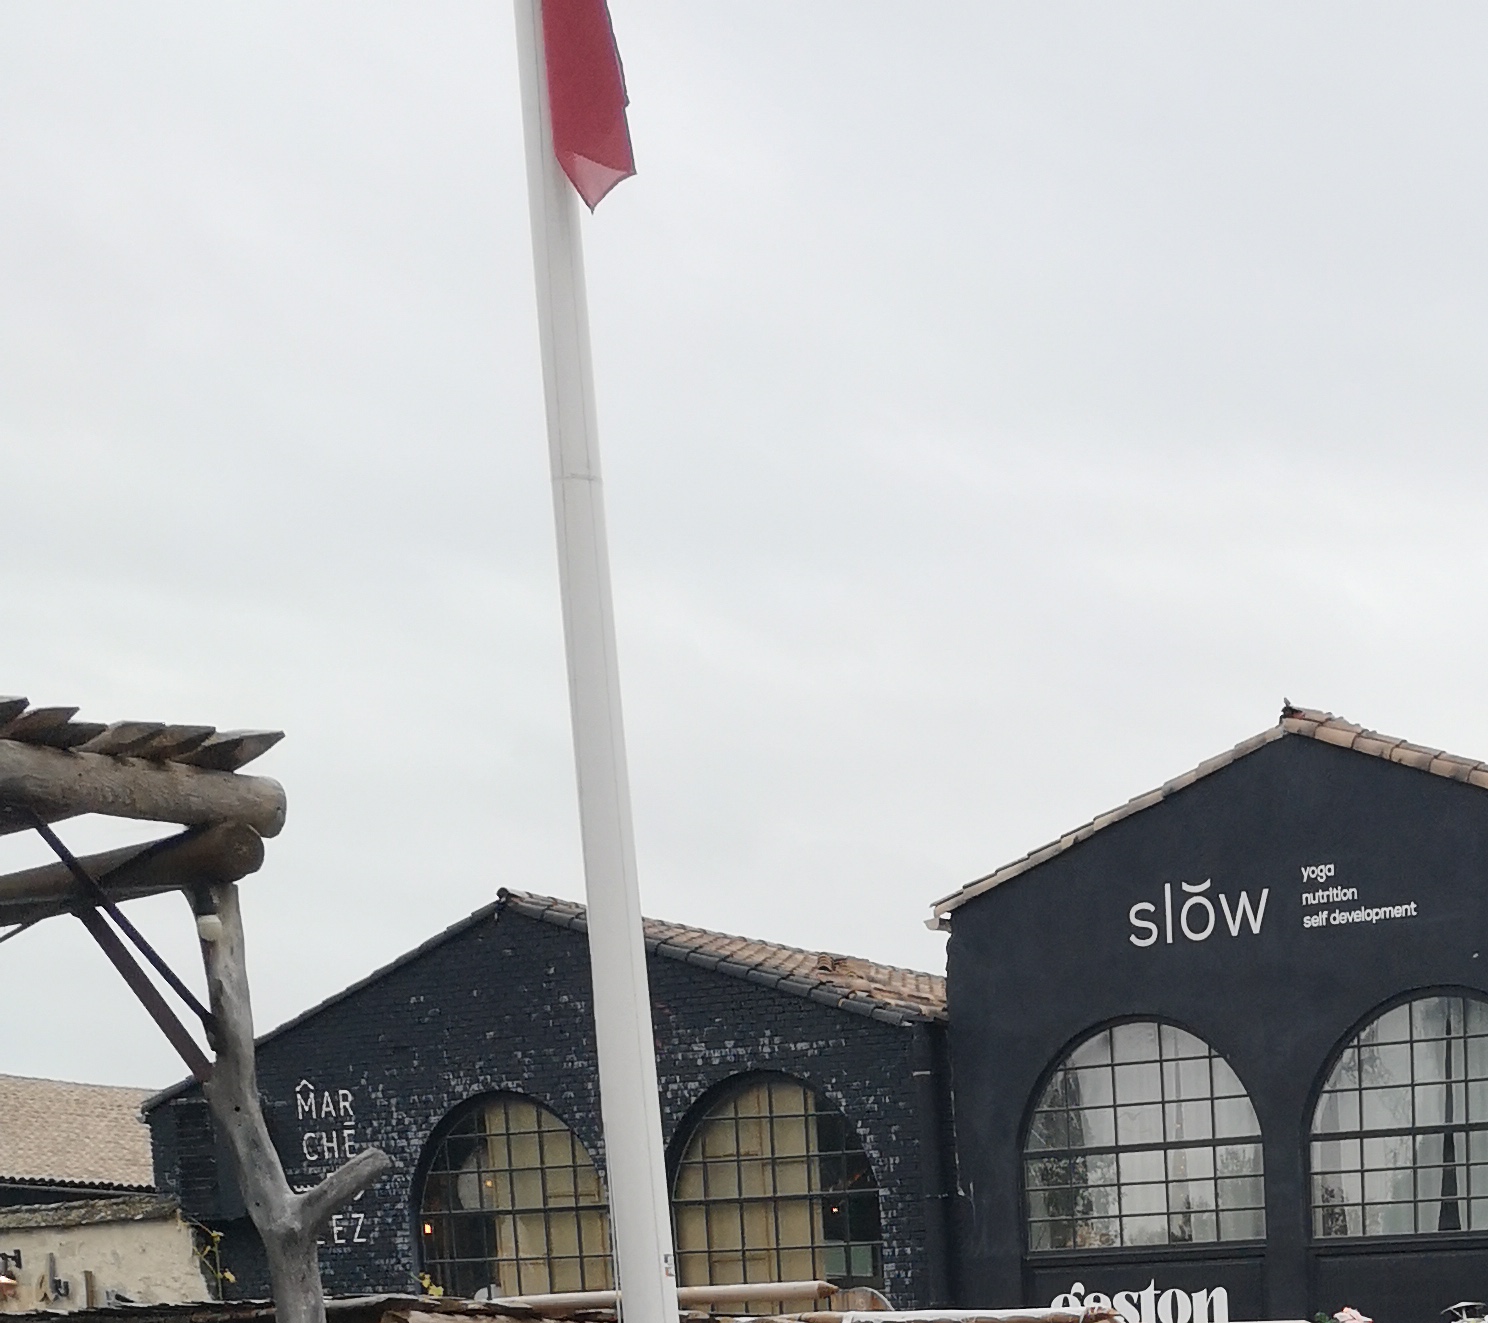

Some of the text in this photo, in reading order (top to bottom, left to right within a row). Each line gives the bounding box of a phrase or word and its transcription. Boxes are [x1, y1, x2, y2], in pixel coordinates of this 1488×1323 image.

[1301, 863, 1335, 883] yoga
[1302, 885, 1358, 906] nutrition
[1303, 901, 1418, 928] self development
[316, 1213, 367, 1244] EZ
